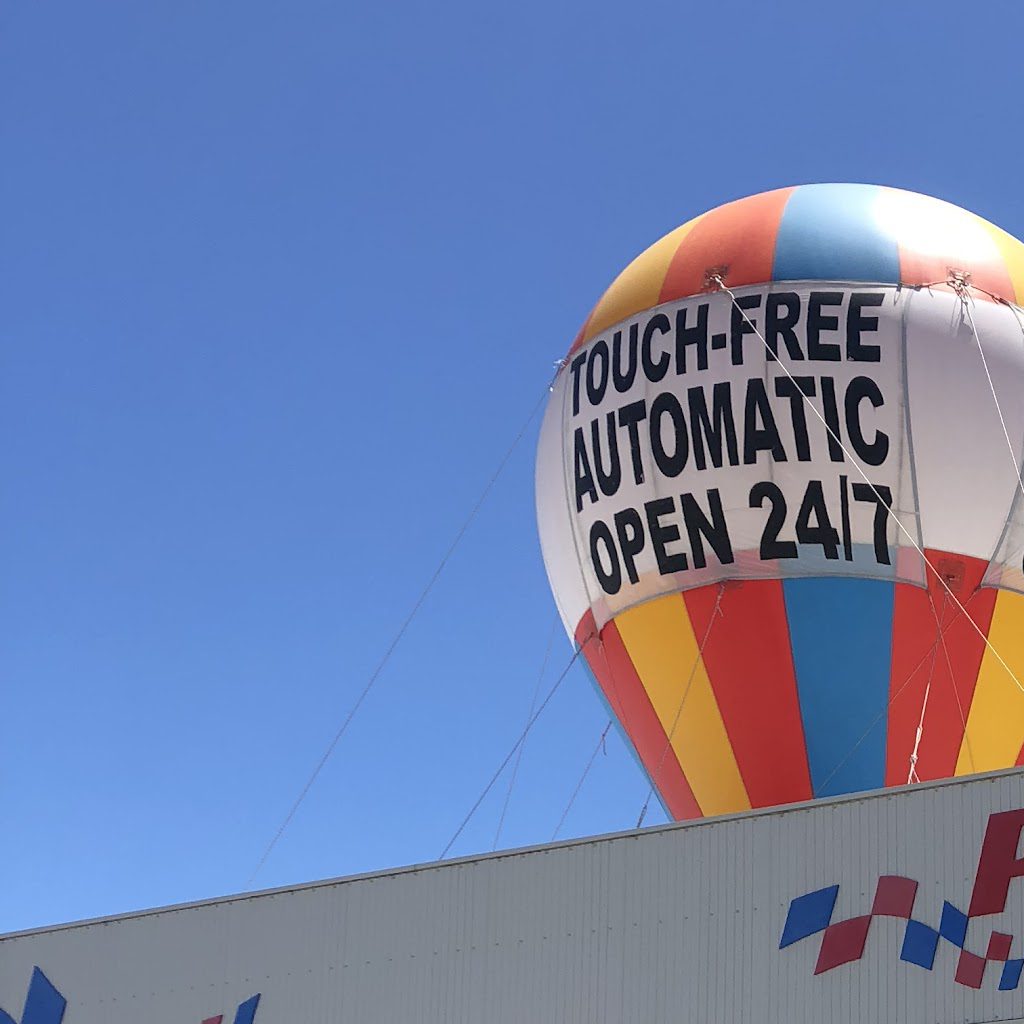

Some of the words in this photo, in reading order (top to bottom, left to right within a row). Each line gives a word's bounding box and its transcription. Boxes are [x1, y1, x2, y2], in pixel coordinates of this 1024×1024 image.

[570, 291, 882, 416] TOUCH-FREE
[573, 376, 890, 514] AUTOMATIC
[588, 488, 734, 596] OPEN
[749, 475, 894, 565] 24/7
